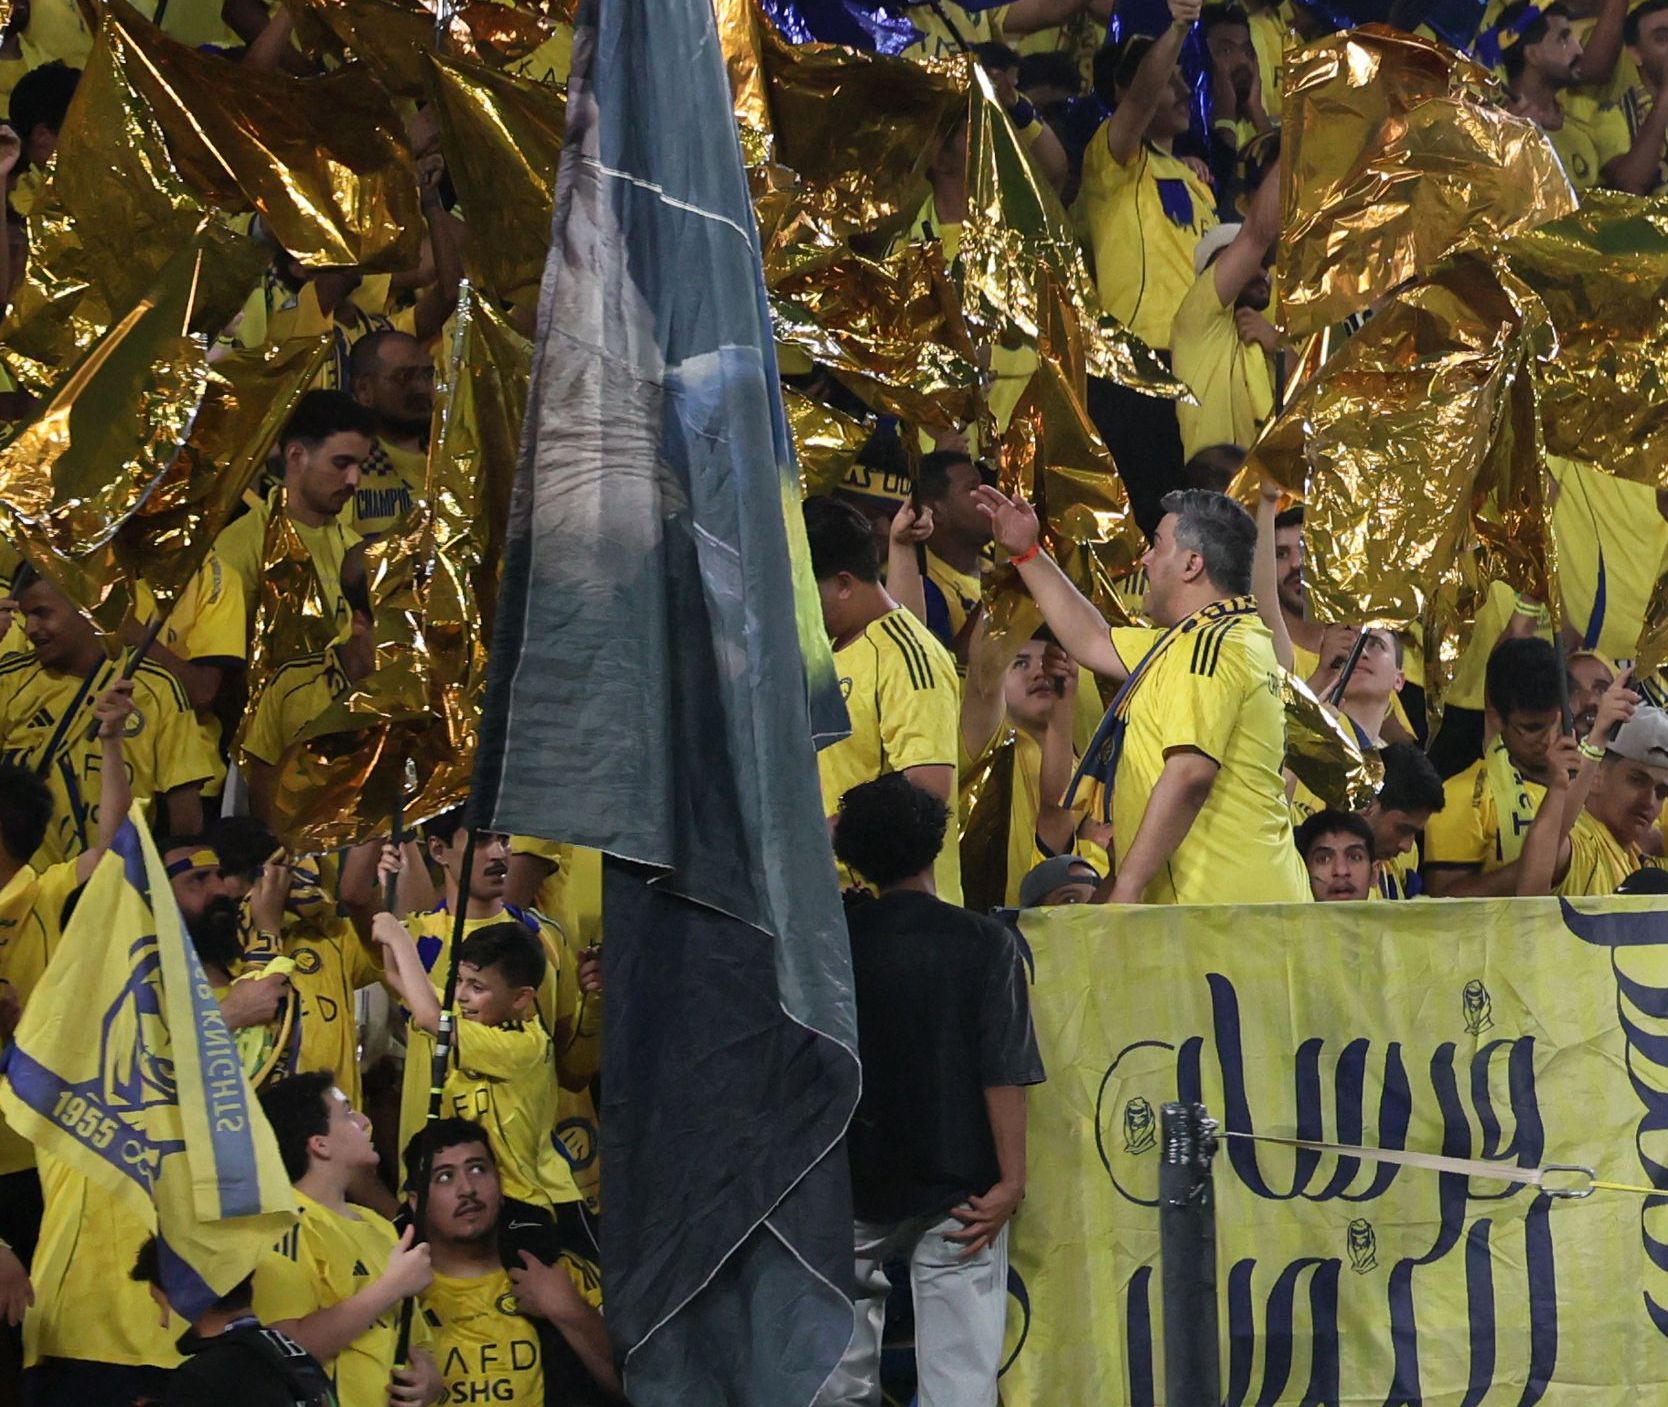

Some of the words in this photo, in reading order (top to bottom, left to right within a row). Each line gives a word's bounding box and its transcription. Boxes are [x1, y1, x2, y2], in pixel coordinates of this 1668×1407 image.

[53, 1090, 120, 1150] 1955
[444, 1339, 538, 1376] AFD
[452, 1379, 514, 1403] SHG
